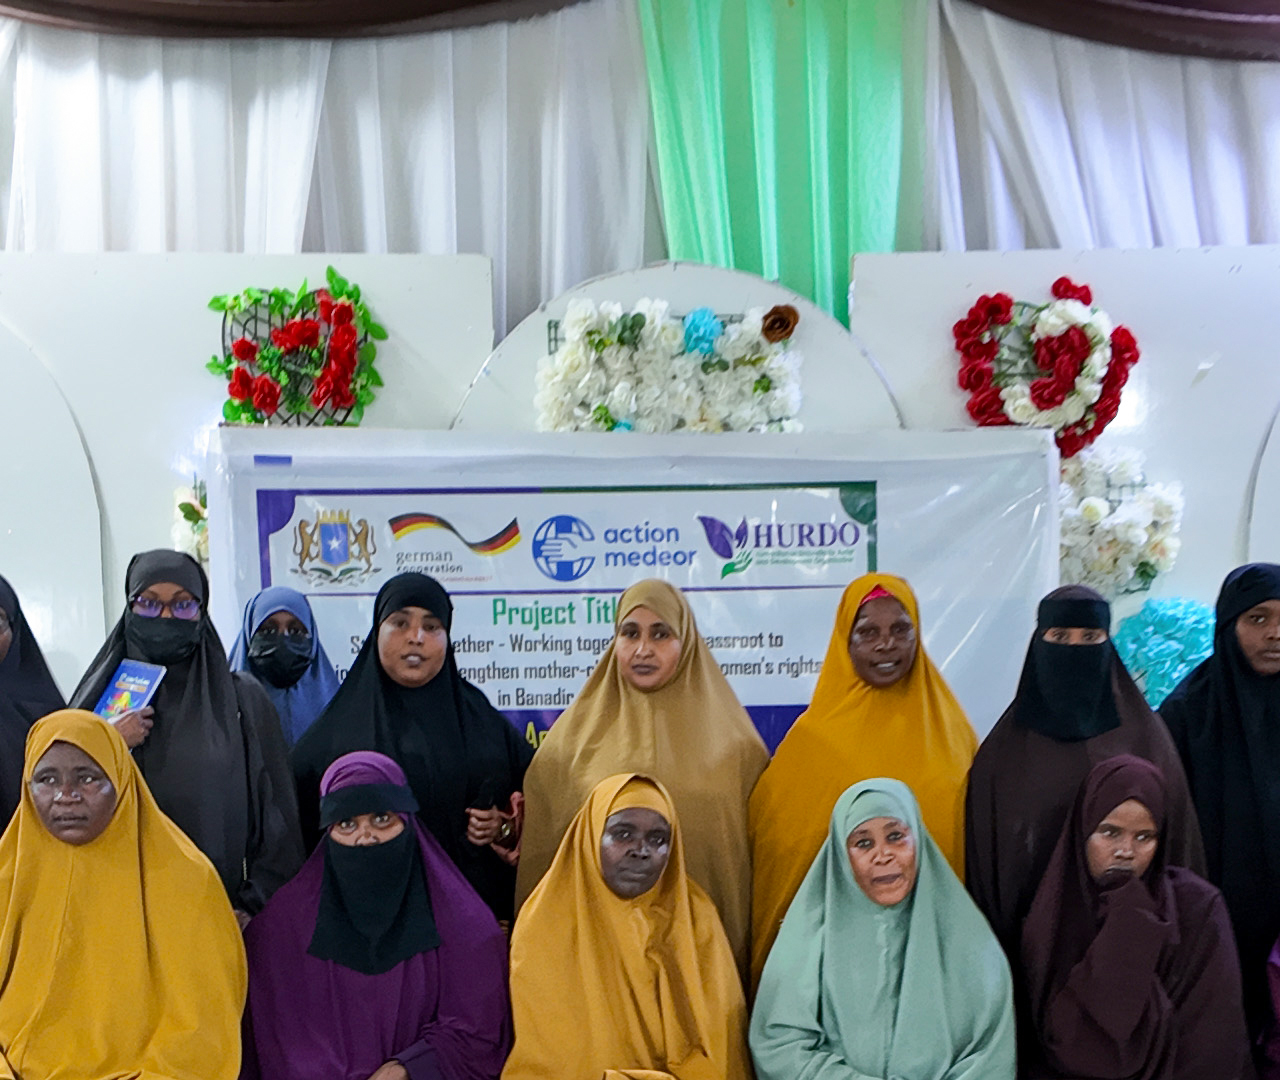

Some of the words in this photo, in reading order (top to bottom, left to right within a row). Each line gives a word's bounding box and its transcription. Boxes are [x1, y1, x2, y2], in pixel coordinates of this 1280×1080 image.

[603, 521, 680, 544] action
[753, 522, 861, 549] HURDO
[396, 551, 453, 565] german
[604, 546, 698, 567] medeor
[493, 598, 576, 631] Project
[350, 635, 366, 654] S
[509, 634, 572, 655] Working
[577, 636, 614, 655] toge
[769, 632, 783, 648] to
[524, 660, 599, 679] mother-r
[498, 690, 511, 706] in
[516, 687, 574, 706] Banadir
